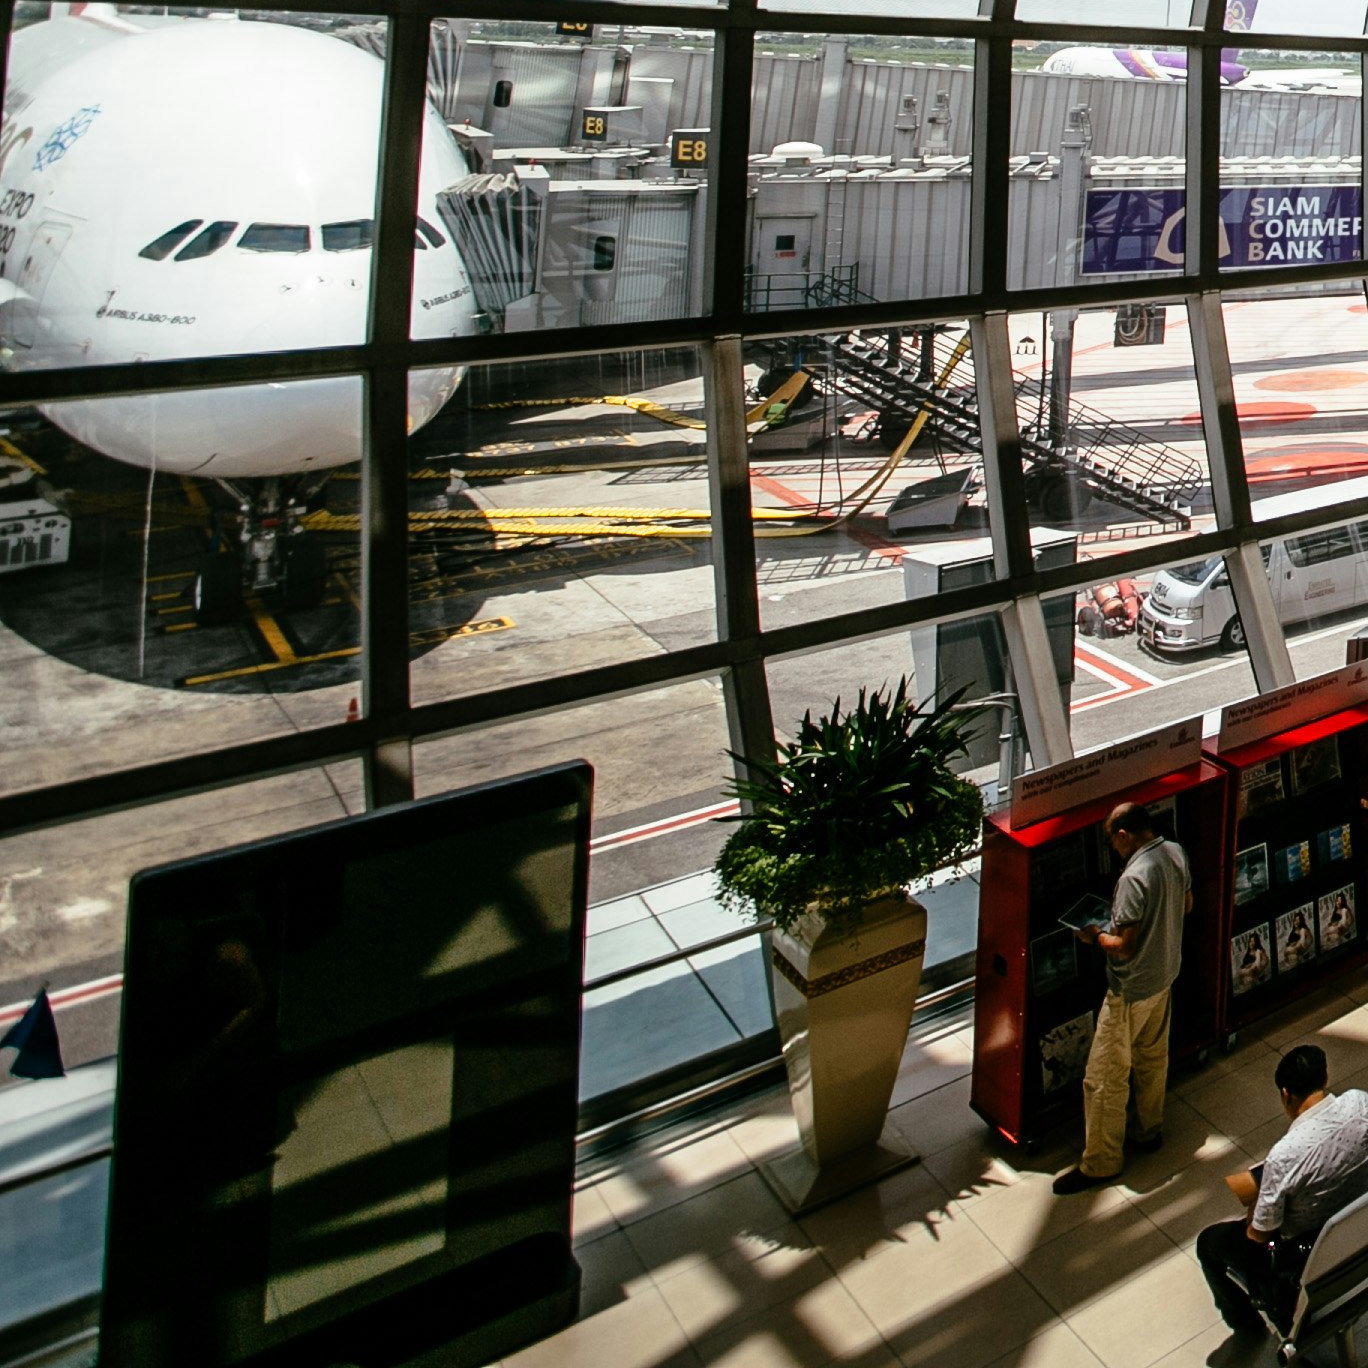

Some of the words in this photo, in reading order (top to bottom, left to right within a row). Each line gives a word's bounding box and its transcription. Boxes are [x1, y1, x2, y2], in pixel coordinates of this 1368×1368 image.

[585, 117, 604, 134] E8
[677, 140, 707, 160] E8
[1250, 196, 1321, 217] SIAM
[1248, 239, 1324, 262] BANK
[106, 308, 138, 321] AIRBUS
[1228, 696, 1281, 720] Newspapers
[1281, 687, 1297, 703] and
[1298, 675, 1340, 699] Magazines
[1022, 763, 1084, 792] Newspapers
[1086, 754, 1106, 771] and
[1107, 739, 1160, 765] Magazines
[1021, 788, 1039, 801] with
[1054, 768, 1101, 791] compliments
